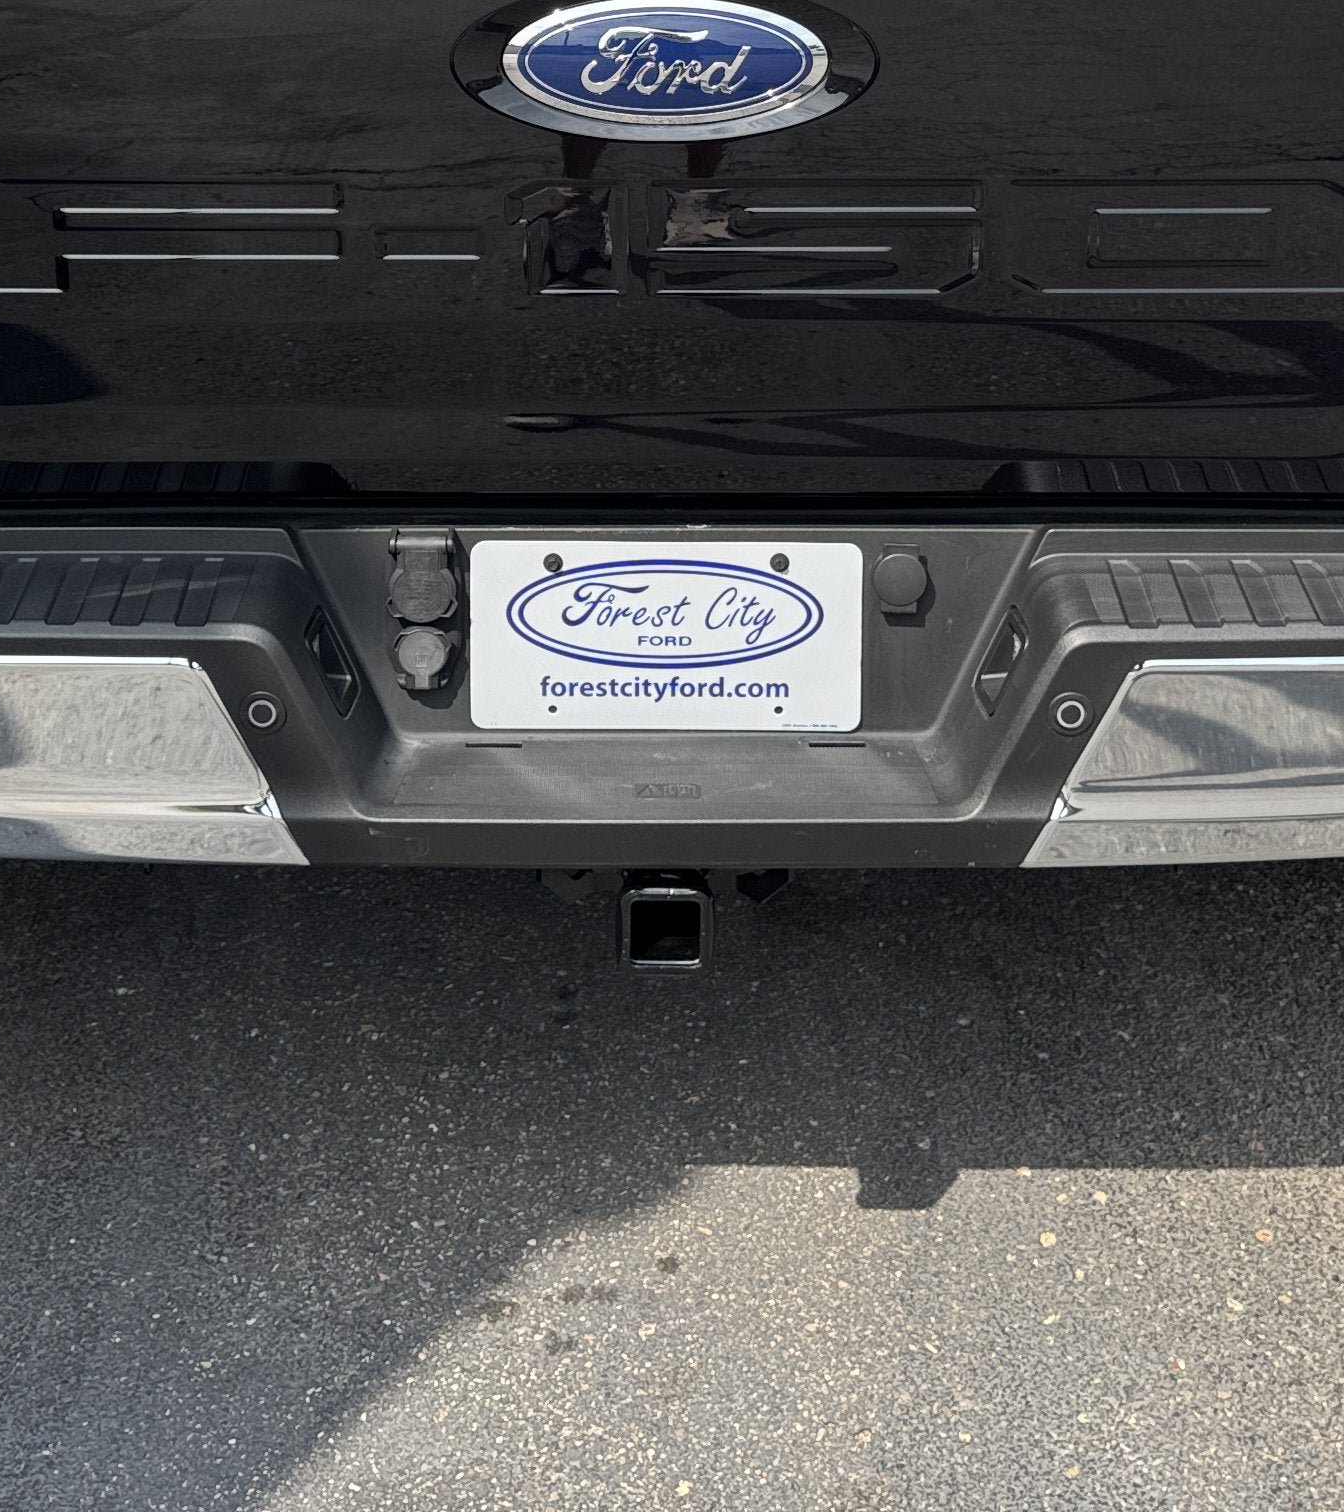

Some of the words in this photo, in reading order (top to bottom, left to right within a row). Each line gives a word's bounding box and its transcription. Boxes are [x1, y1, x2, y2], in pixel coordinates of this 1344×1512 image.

[580, 26, 752, 96] Ford
[561, 582, 692, 627] Forest
[704, 587, 777, 645] City
[637, 635, 693, 647] FORD
[540, 675, 790, 702] forestcityford.com
